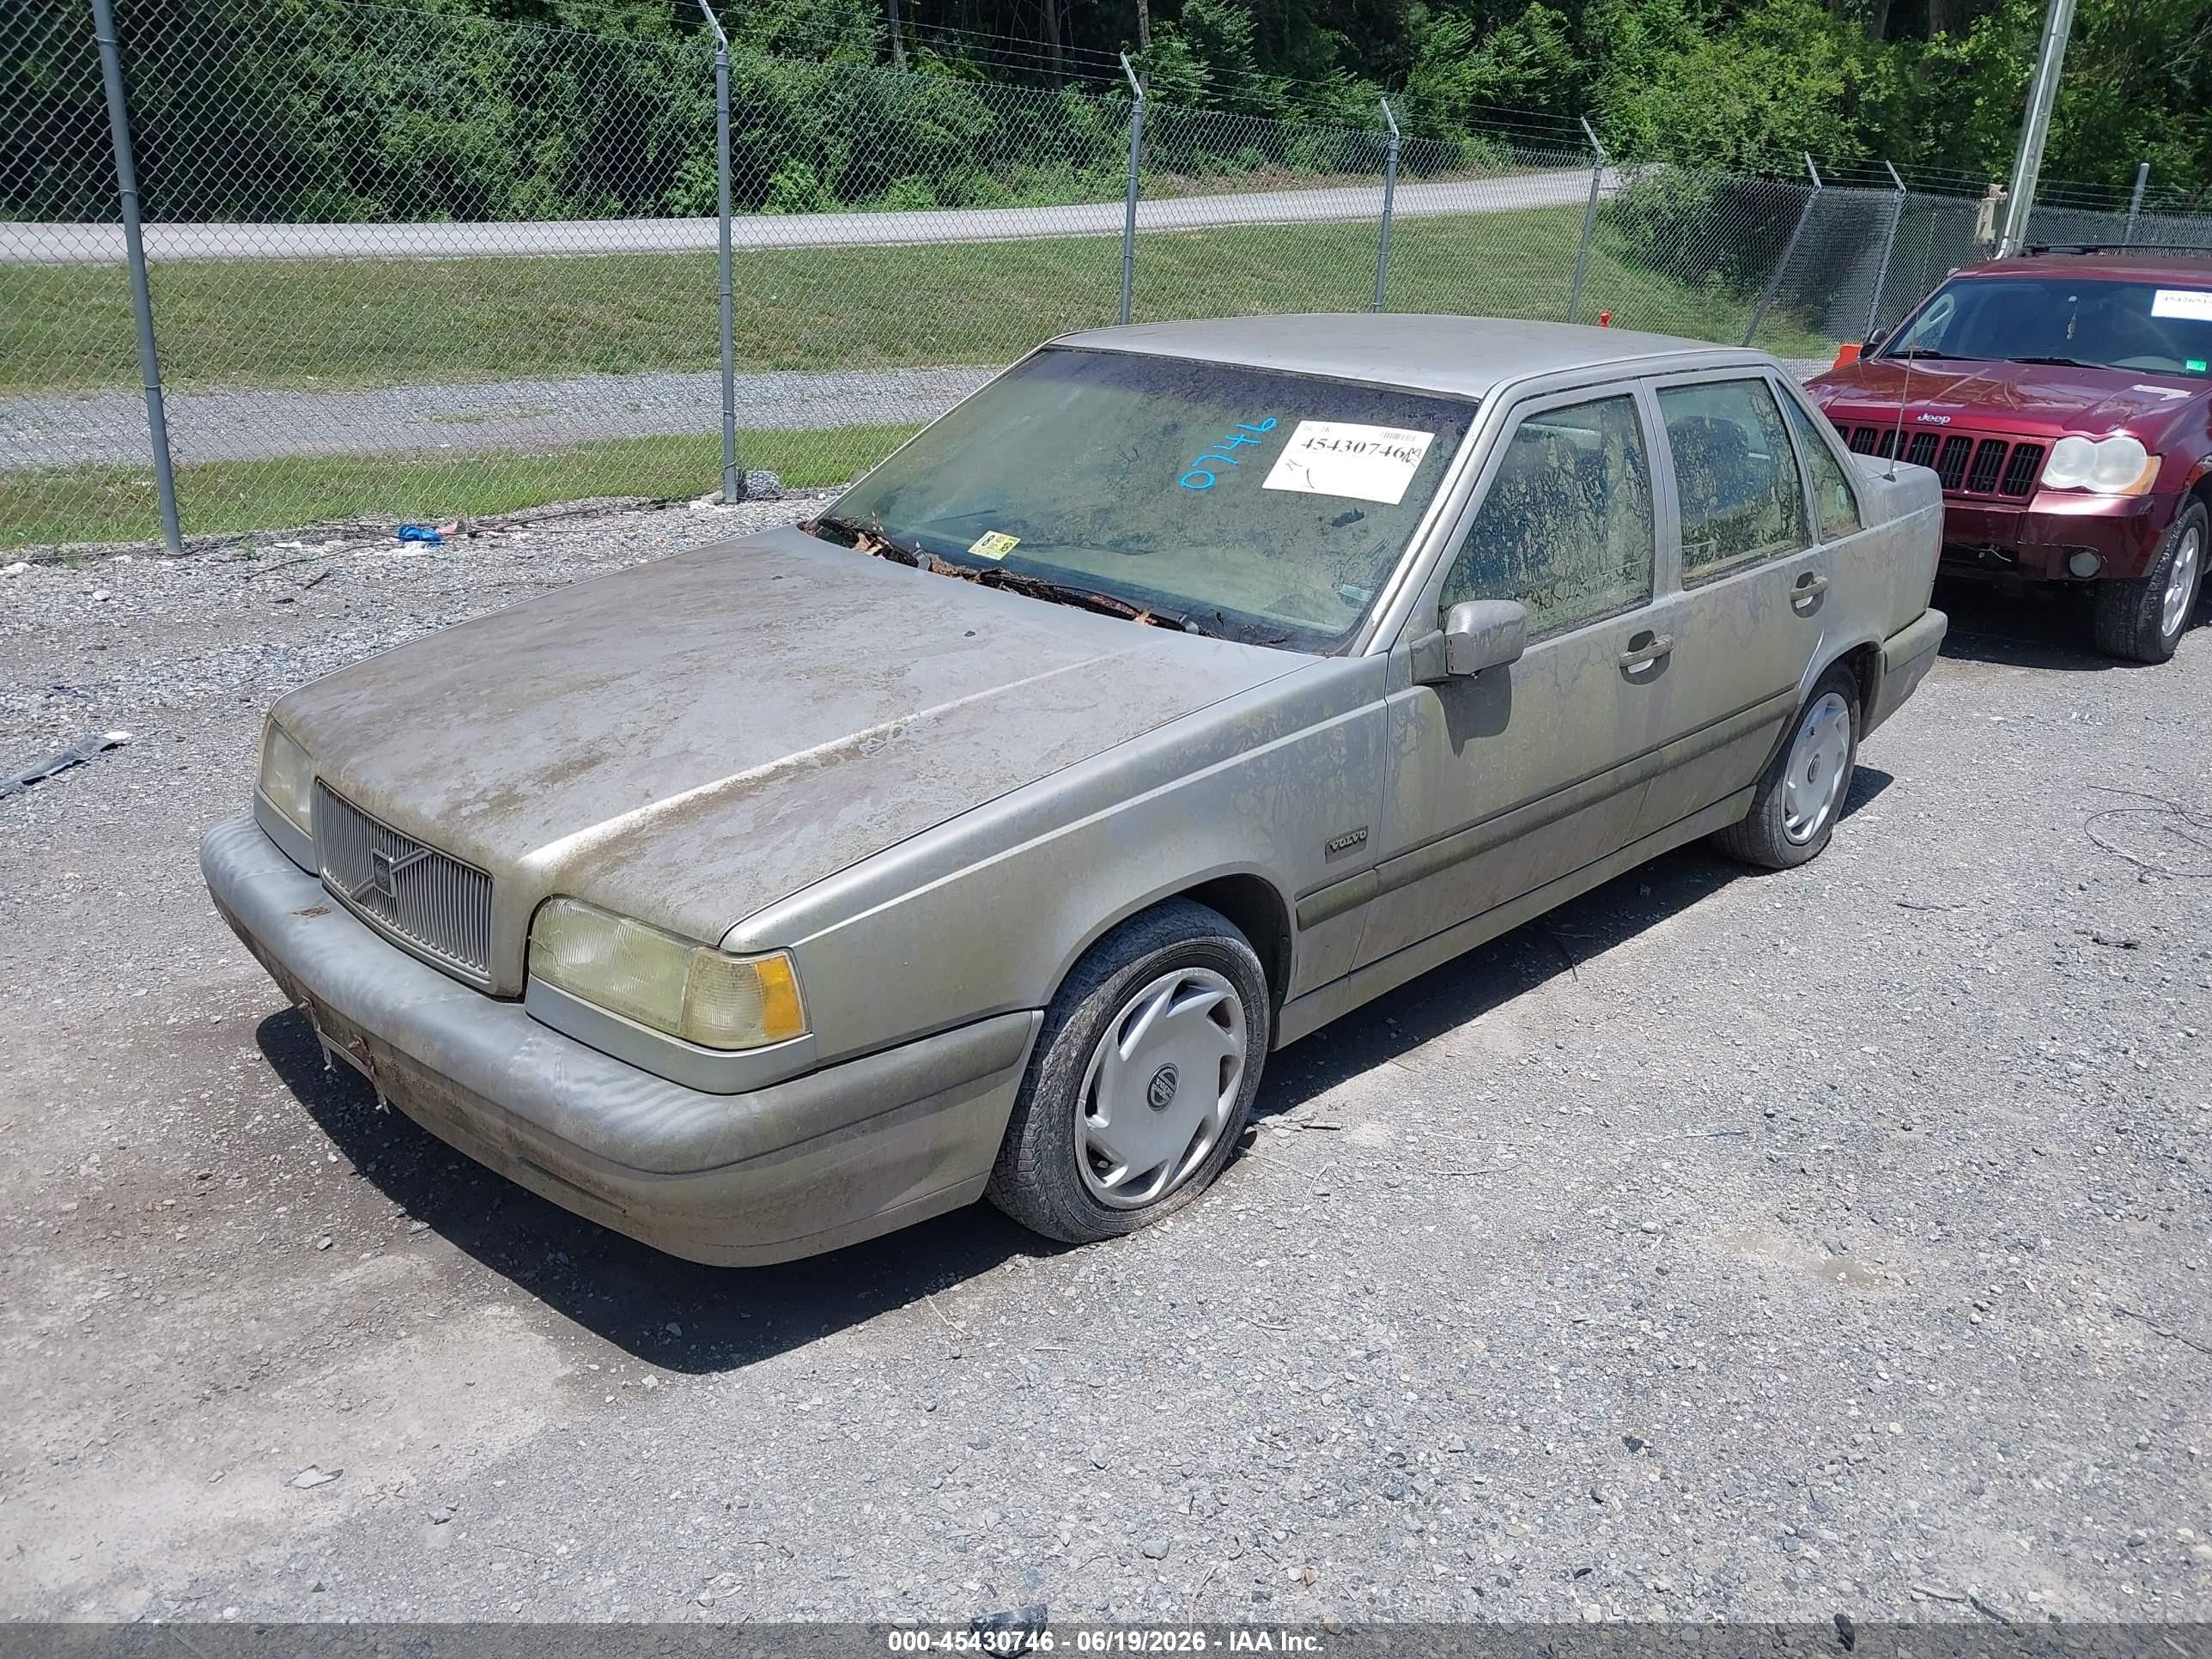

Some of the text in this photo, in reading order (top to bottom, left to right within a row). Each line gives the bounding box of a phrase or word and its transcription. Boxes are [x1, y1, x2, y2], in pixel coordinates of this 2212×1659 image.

[1916, 412, 1952, 425] Jeep
[1181, 417, 1277, 490] 0746
[1300, 437, 1407, 459] 45430746
[1330, 830, 1366, 851] VOLVO
